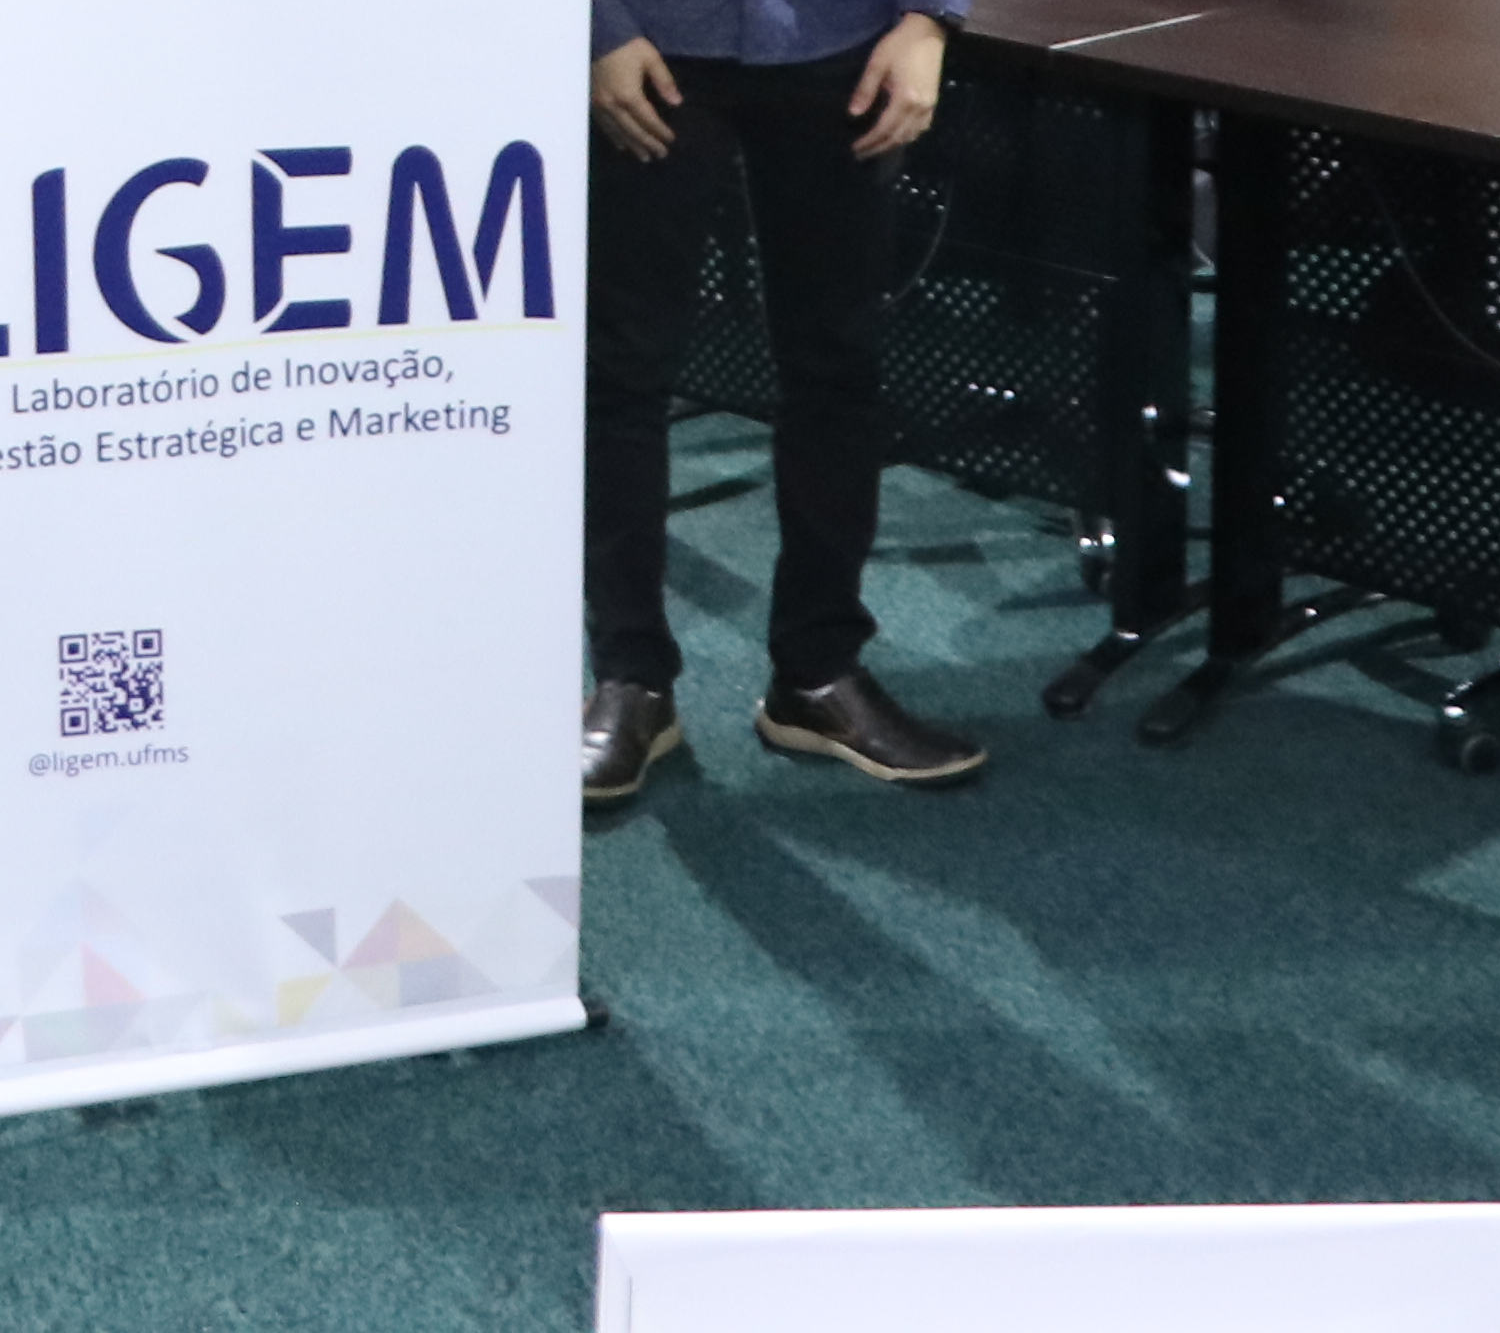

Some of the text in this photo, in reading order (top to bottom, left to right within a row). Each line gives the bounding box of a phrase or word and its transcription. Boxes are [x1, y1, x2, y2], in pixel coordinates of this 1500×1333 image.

[11, 348, 454, 414] Laboratório de Inovação,
[96, 417, 285, 463] Estratégica
[296, 418, 315, 441] e
[328, 397, 512, 439] Marketing
[28, 743, 191, 777] @ligem.ufms
